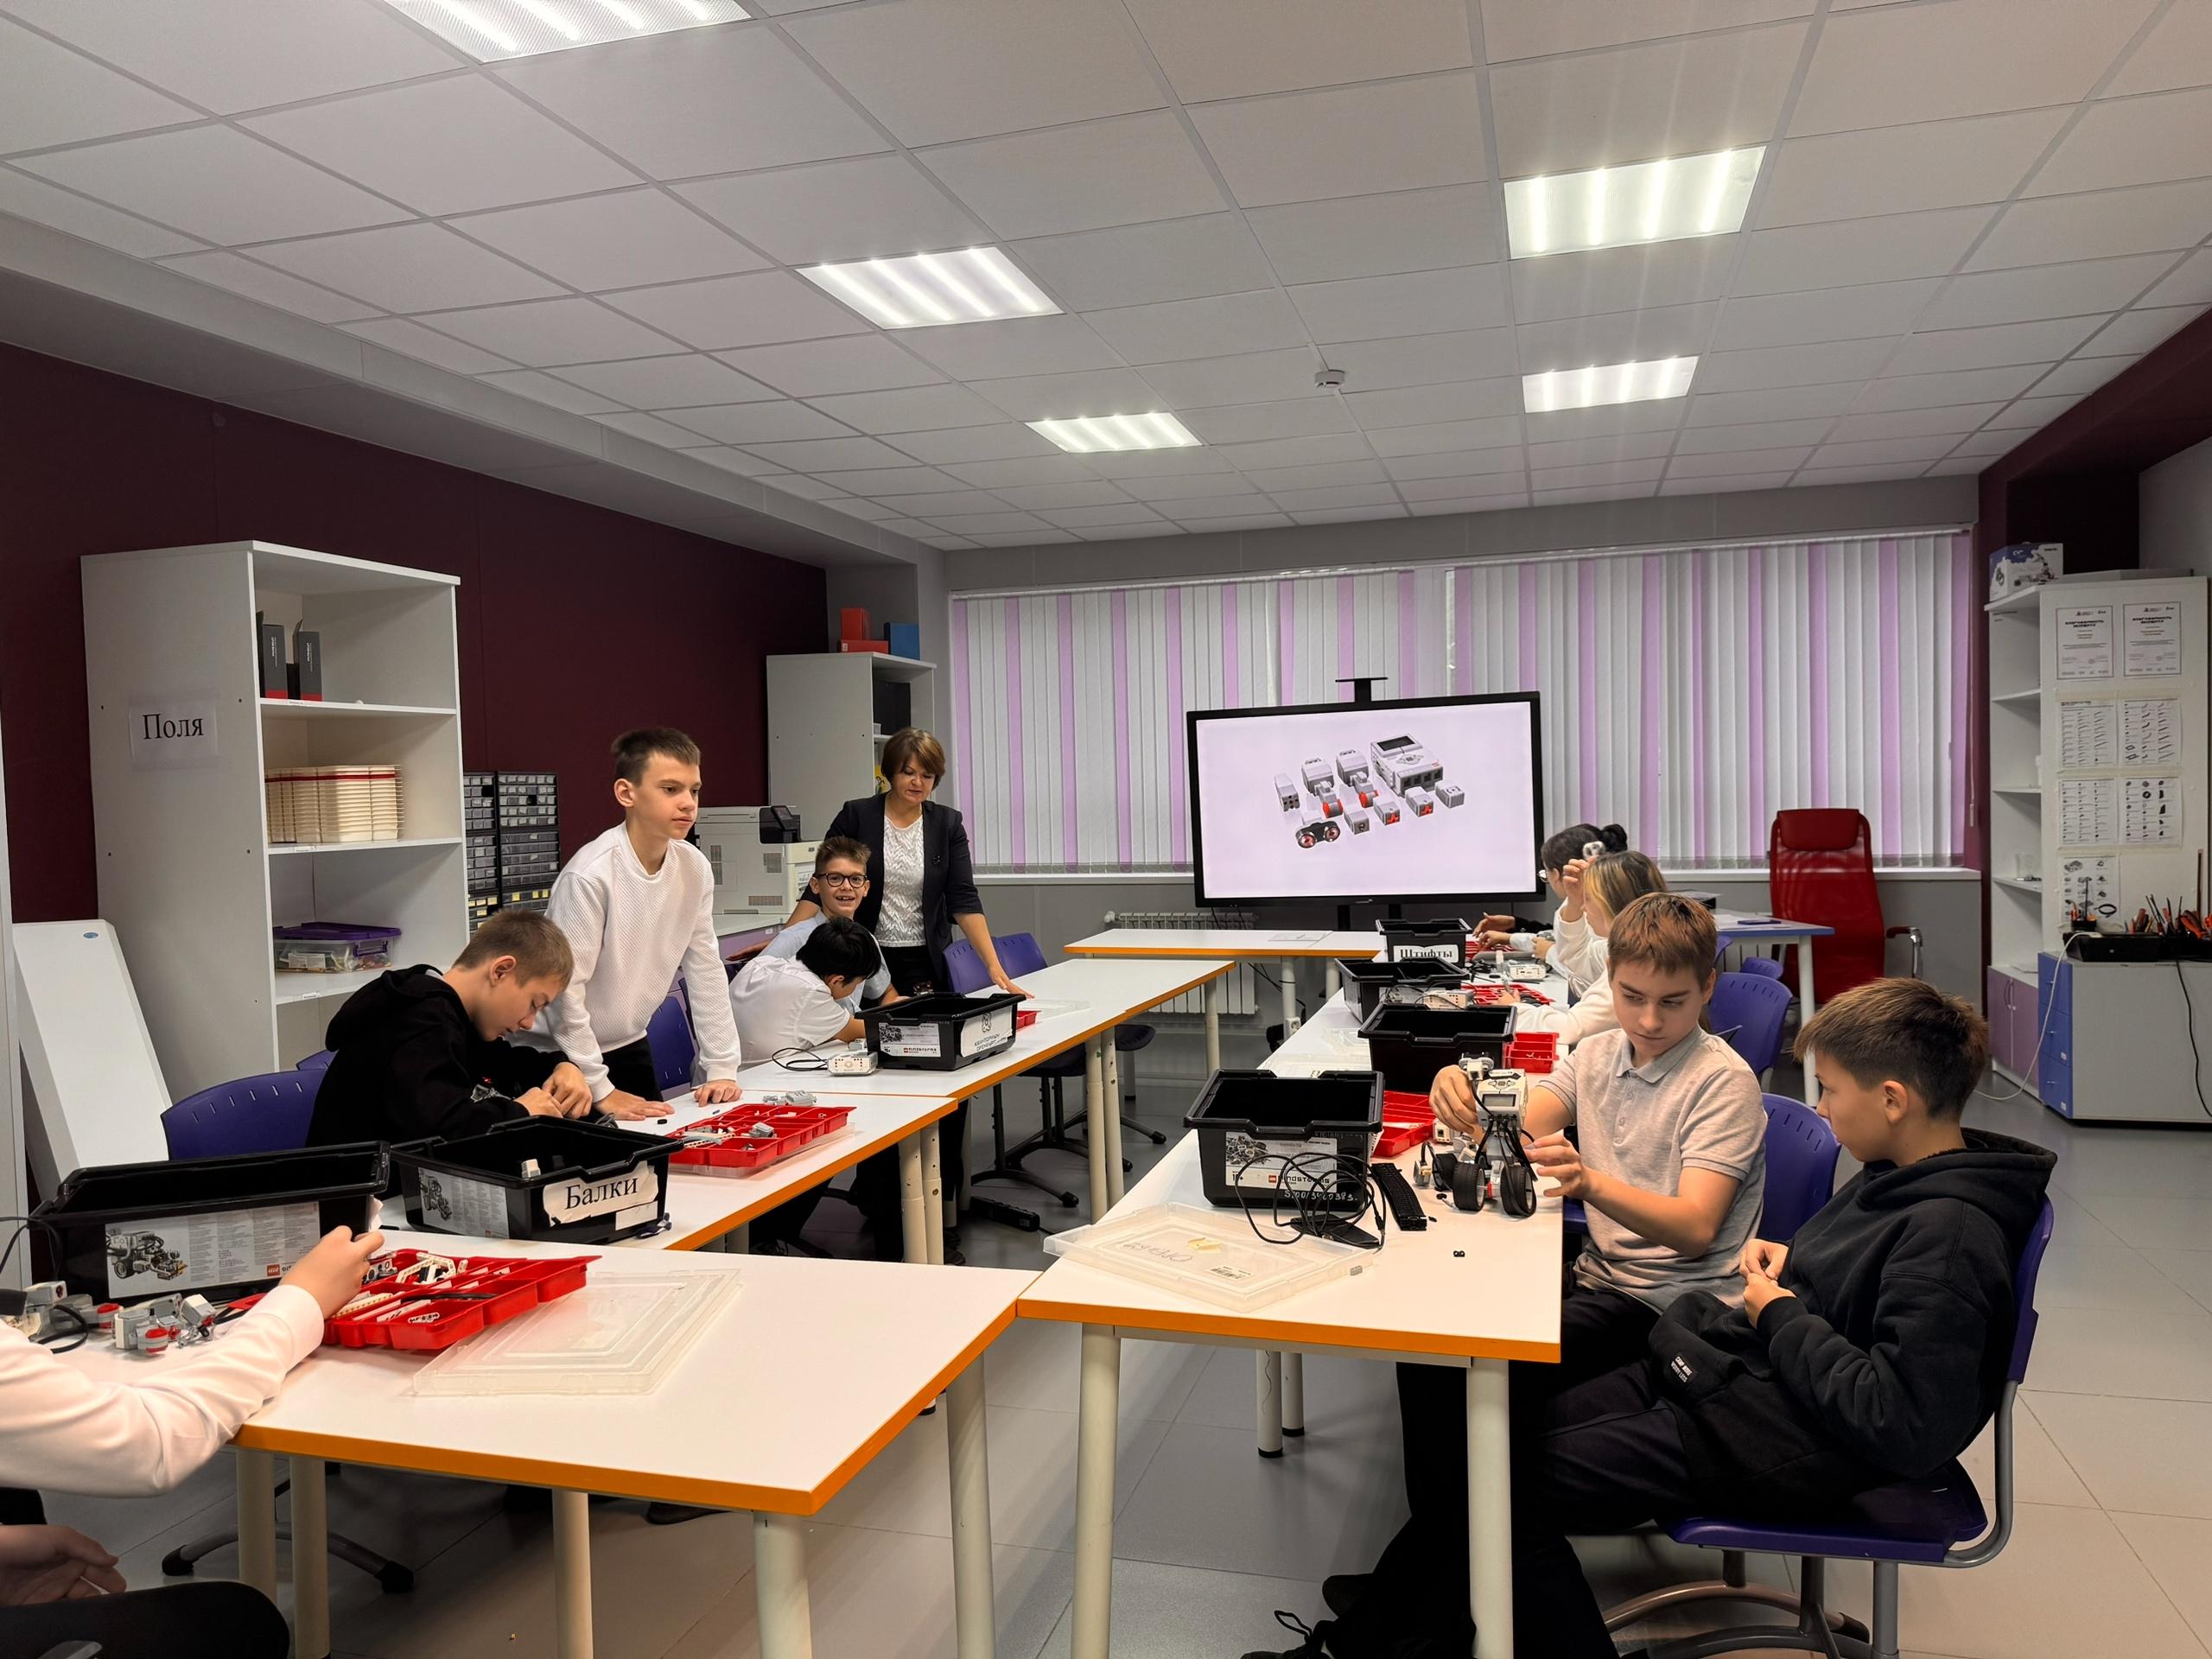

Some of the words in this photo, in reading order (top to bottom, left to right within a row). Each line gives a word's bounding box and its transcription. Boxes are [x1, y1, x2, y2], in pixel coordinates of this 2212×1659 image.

[142, 714, 204, 740] Поля
[1400, 949, 1452, 958] Штифты
[564, 1178, 639, 1210] Балки
